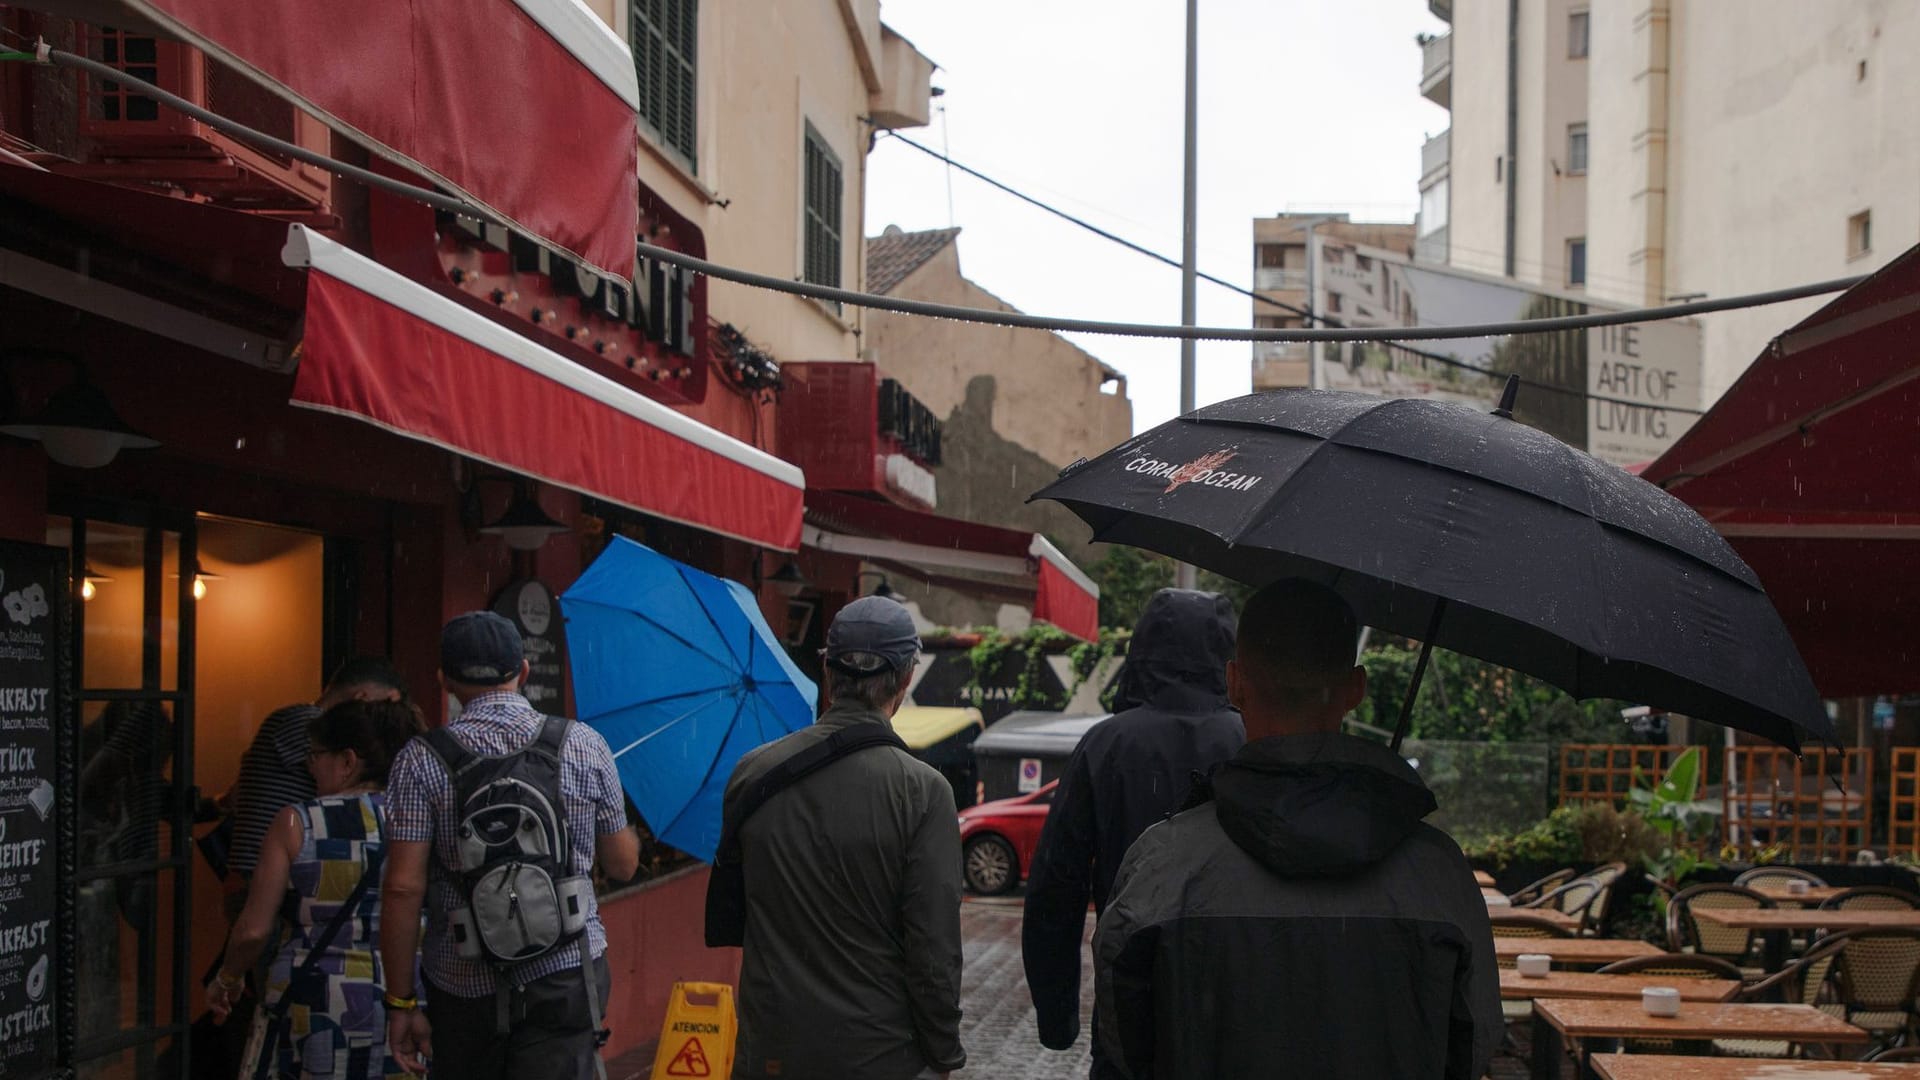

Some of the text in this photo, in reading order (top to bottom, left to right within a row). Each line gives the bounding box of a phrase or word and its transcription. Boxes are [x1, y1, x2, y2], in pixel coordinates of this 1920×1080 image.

[1601, 325, 1640, 358] THE
[1597, 360, 1678, 401] ART OF
[1124, 457, 1262, 492] CORAL OCEAN
[671, 1021, 720, 1034] ATENCION
